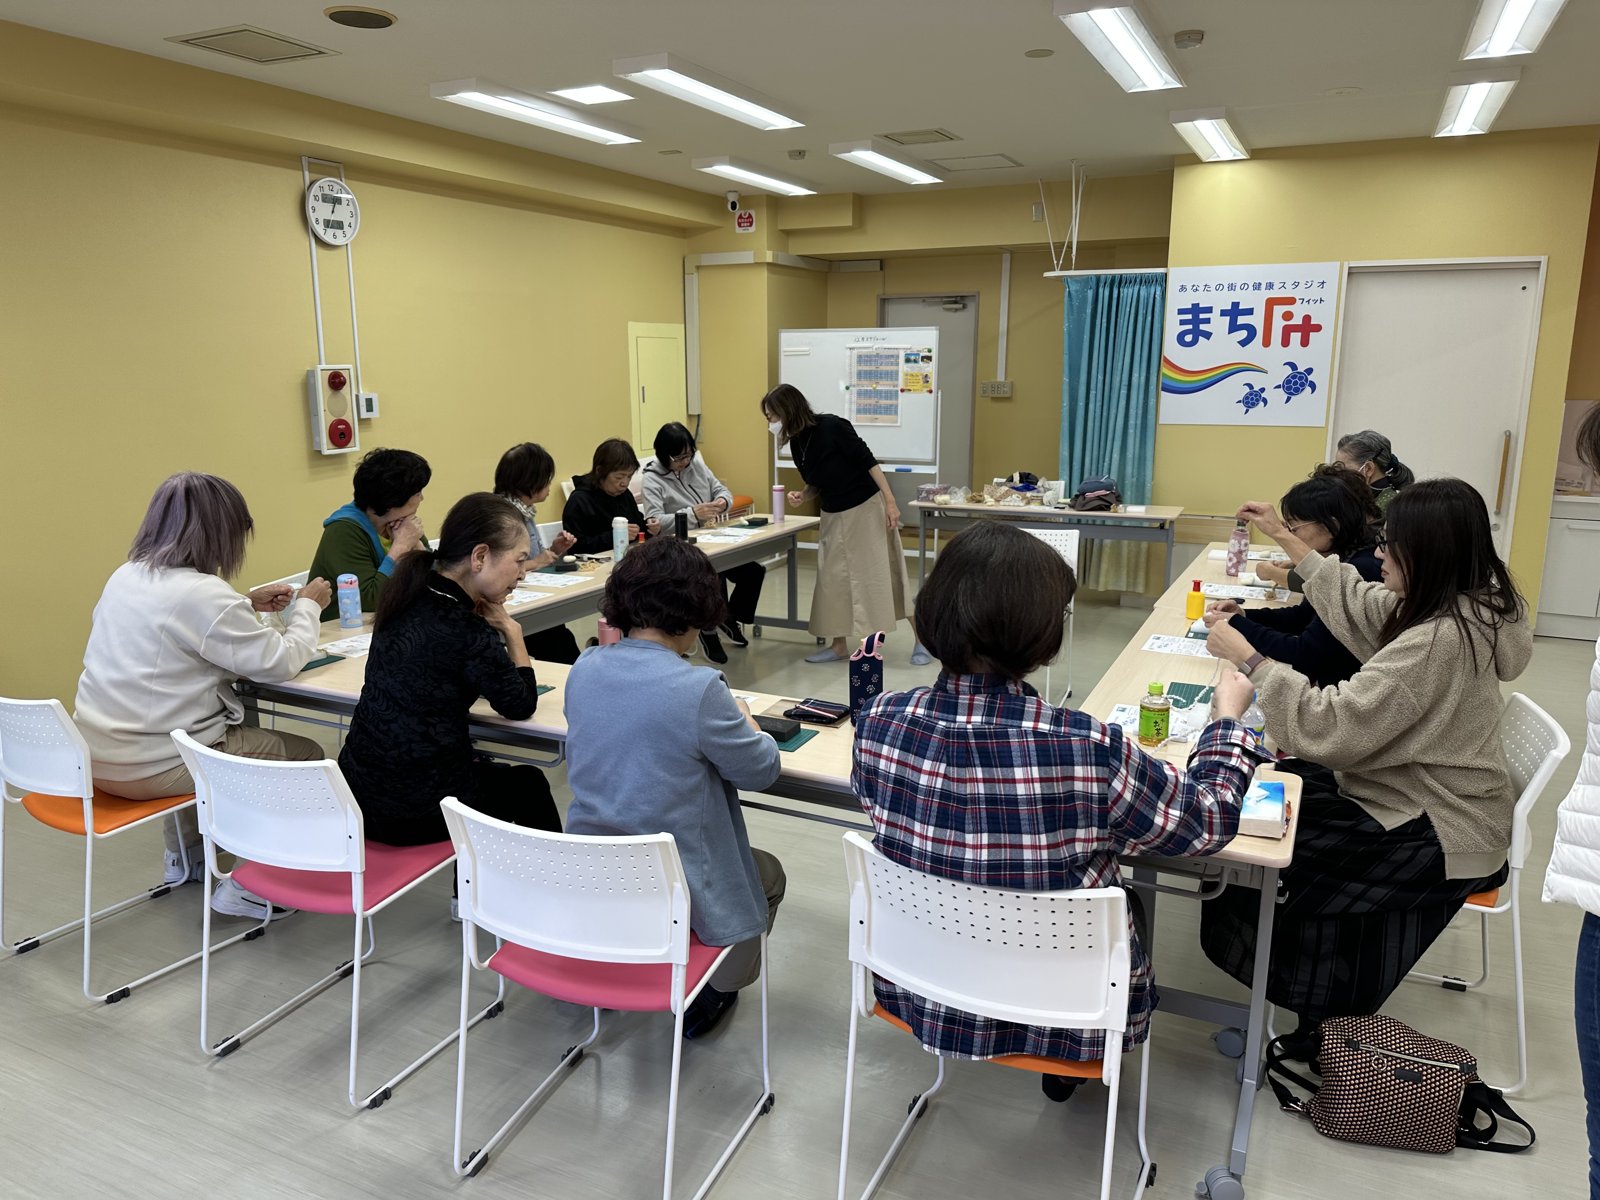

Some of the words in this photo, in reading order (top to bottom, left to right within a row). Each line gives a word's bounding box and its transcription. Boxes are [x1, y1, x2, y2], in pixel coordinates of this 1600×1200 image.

[1178, 279, 1327, 293] あなたの街の健康スタジオ
[1298, 296, 1325, 305] フィット
